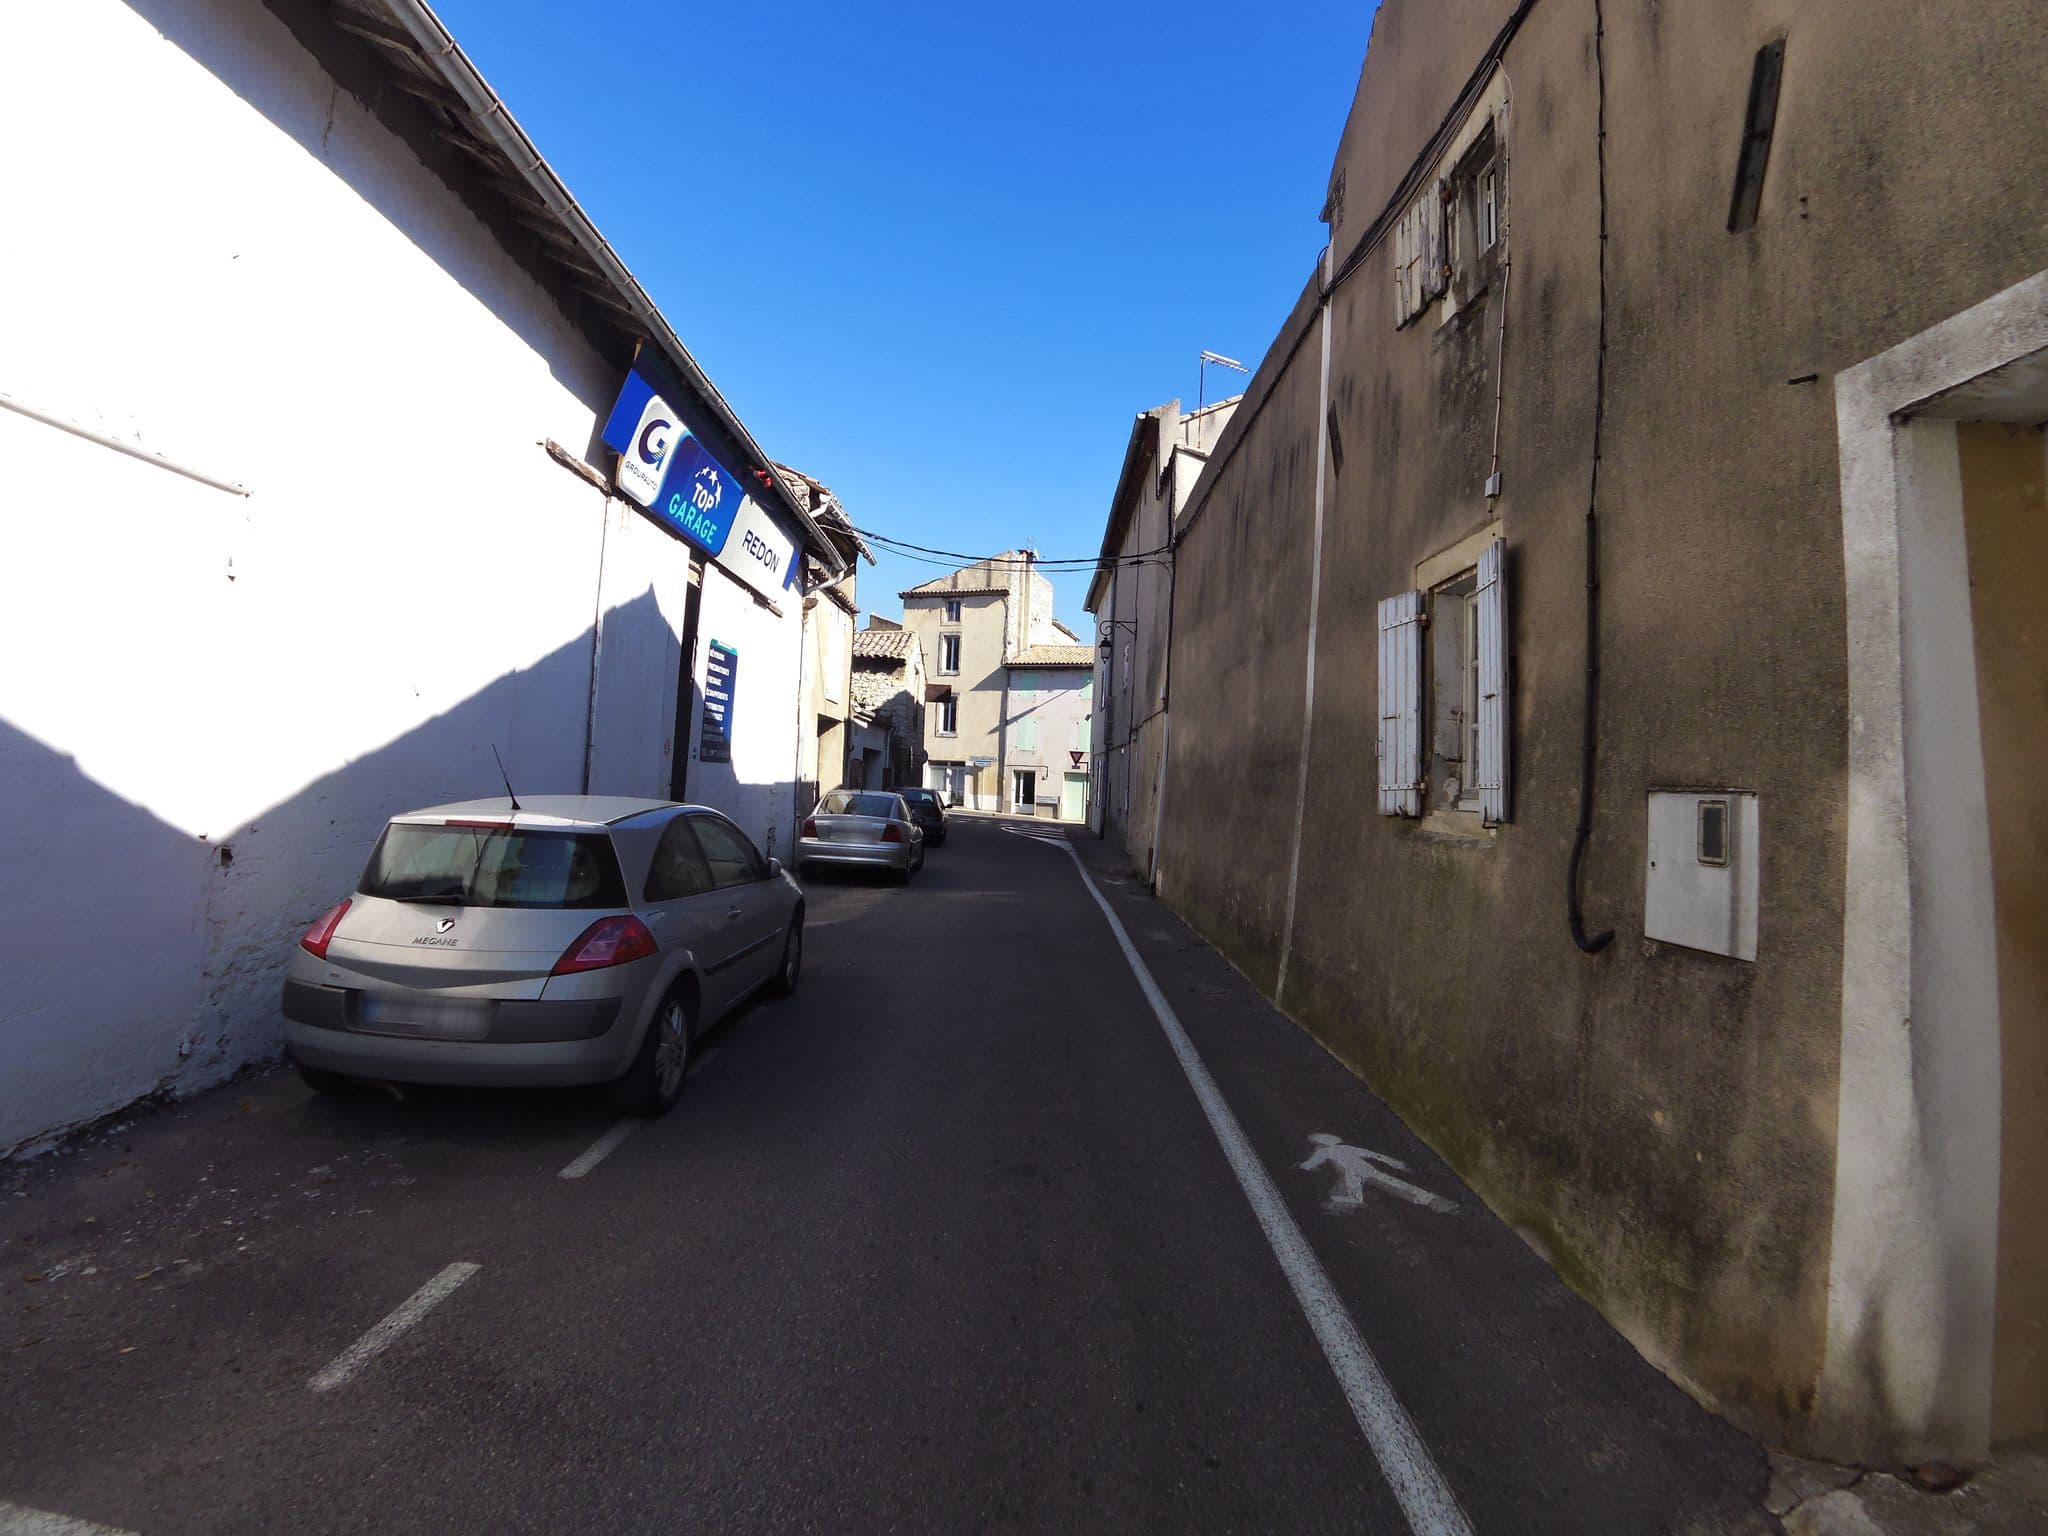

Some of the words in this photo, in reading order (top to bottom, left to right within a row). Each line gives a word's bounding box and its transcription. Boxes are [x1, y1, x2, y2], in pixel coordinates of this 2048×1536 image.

[625, 461, 657, 490] GROUPAUTO
[692, 482, 714, 512] TOP
[669, 494, 717, 544] GARAGE
[742, 529, 779, 573] REDON
[412, 937, 459, 947] MEGANE
